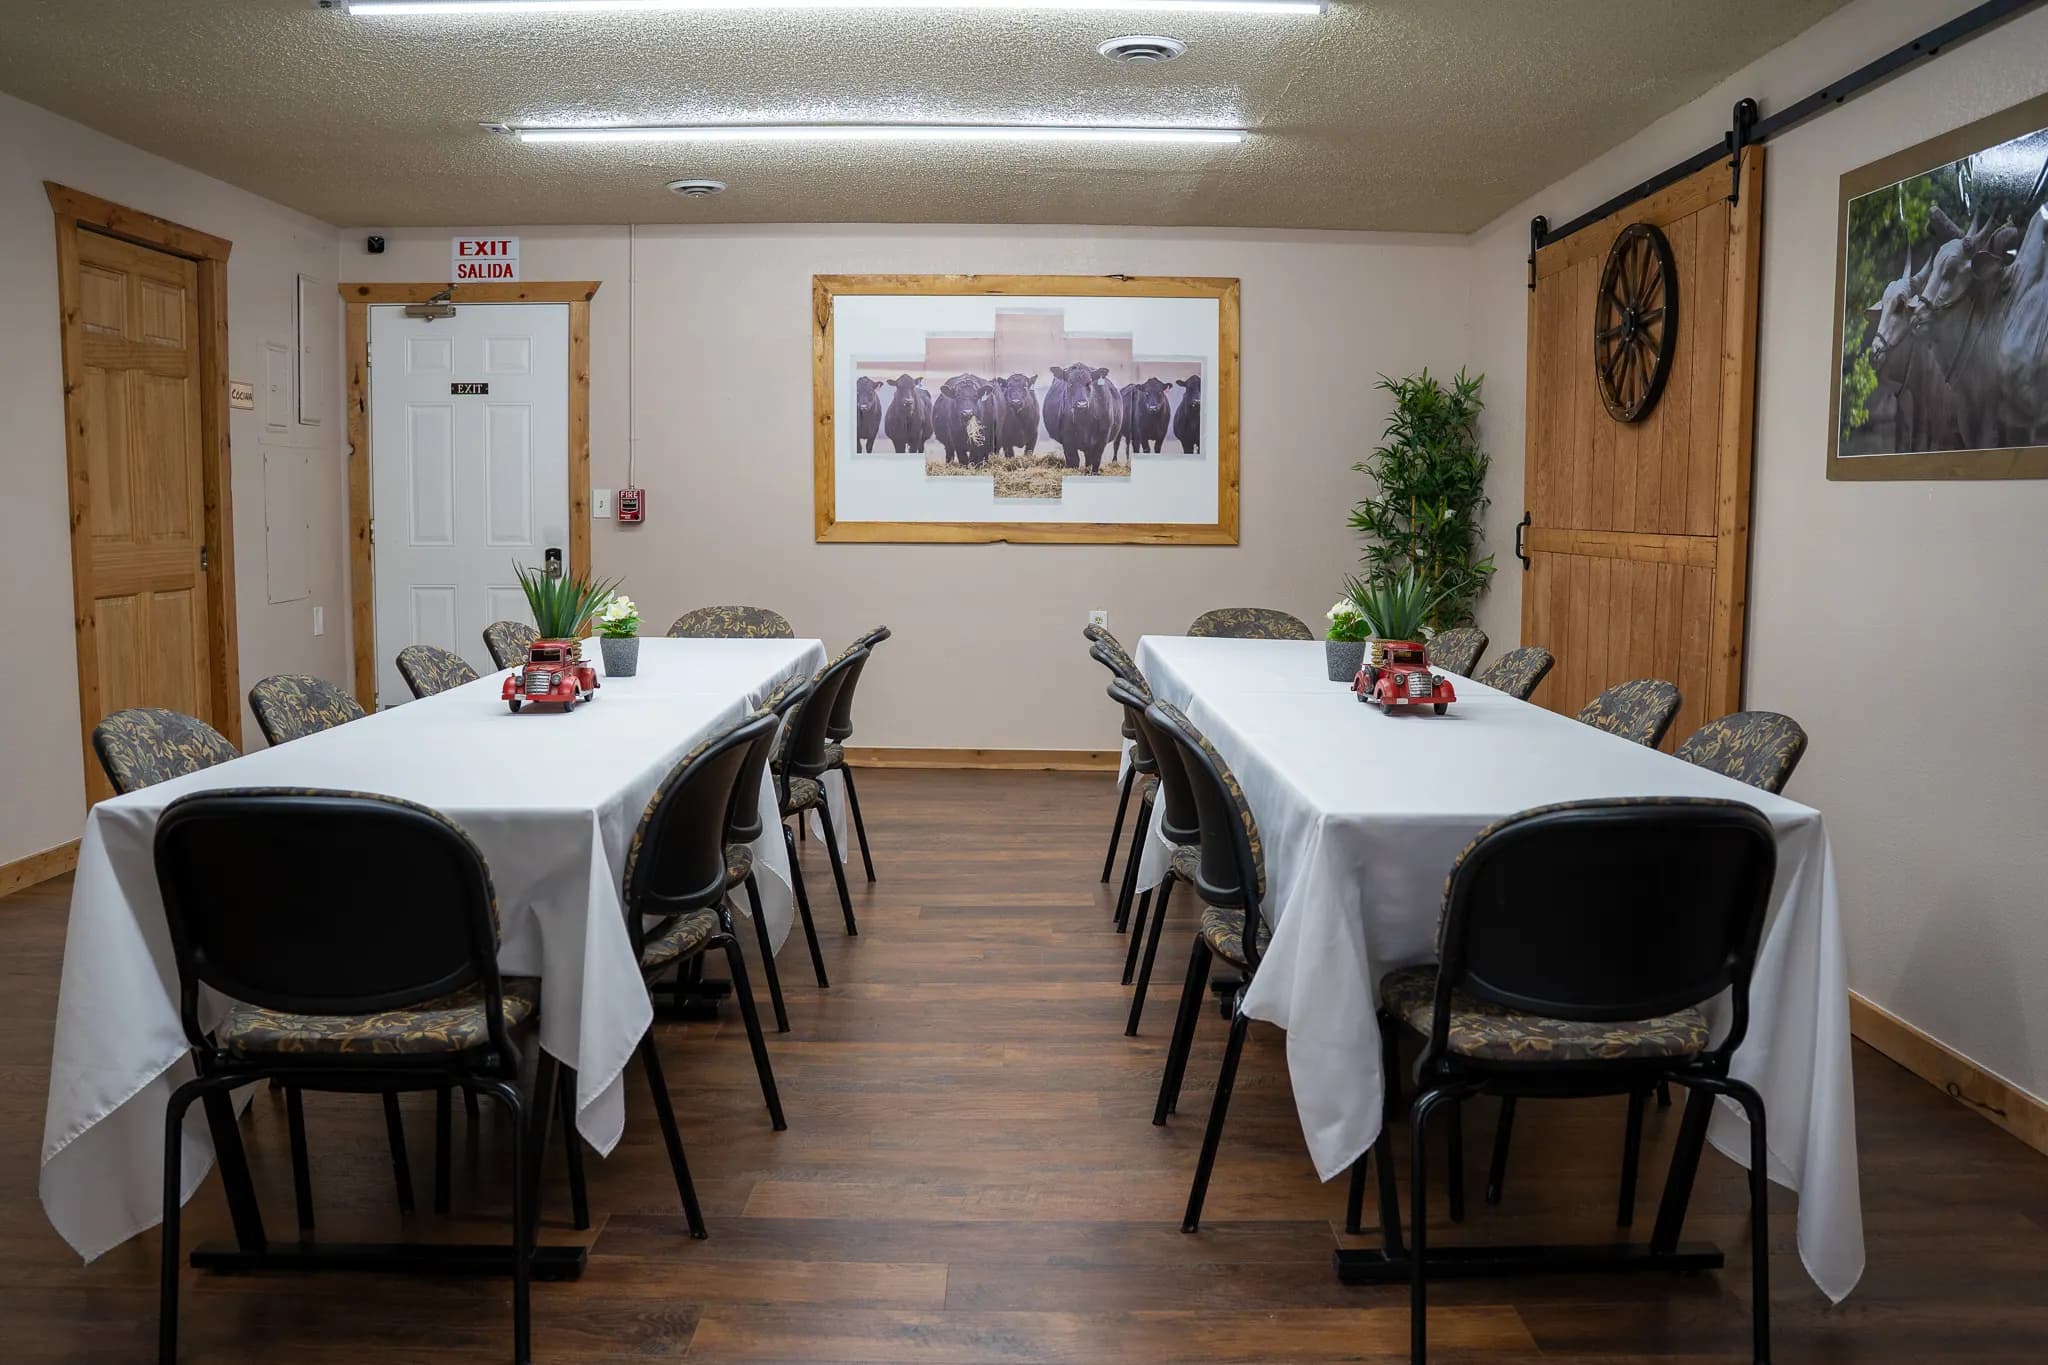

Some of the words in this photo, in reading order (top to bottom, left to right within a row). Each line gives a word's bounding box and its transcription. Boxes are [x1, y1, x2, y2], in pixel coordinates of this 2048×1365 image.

[459, 240, 512, 257] EXIT
[457, 263, 514, 279] SALIDA
[457, 384, 483, 394] EXIT
